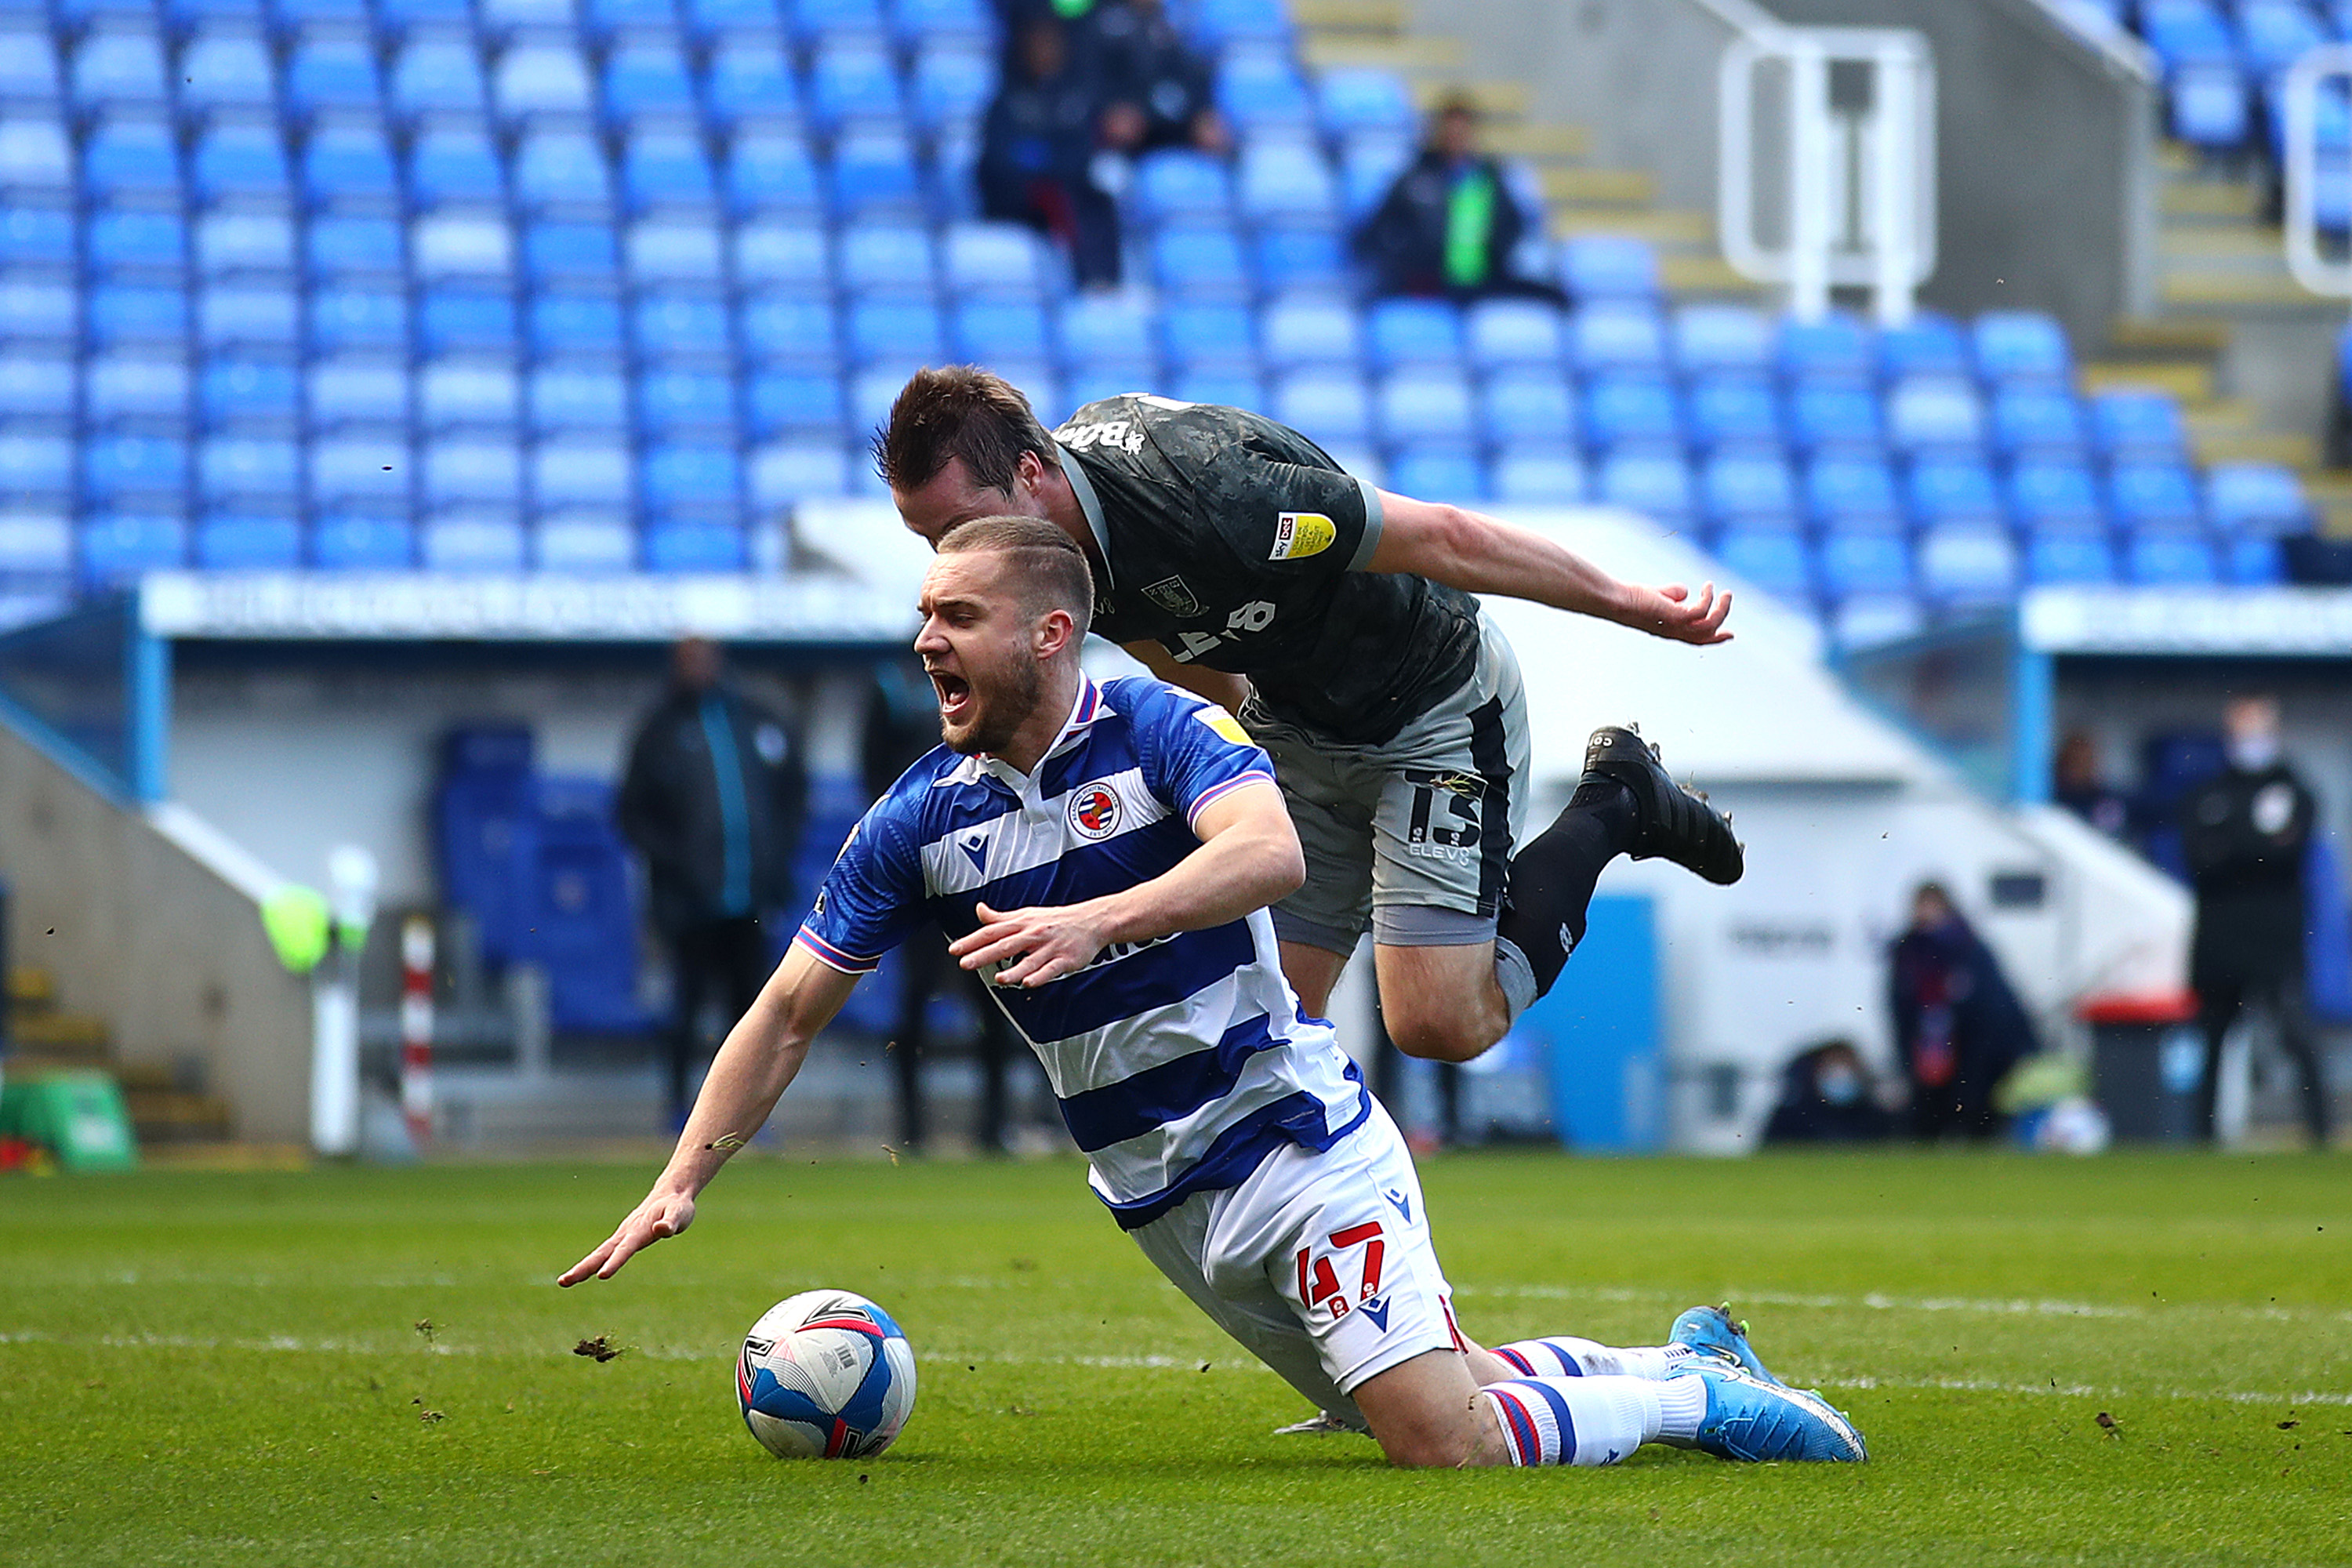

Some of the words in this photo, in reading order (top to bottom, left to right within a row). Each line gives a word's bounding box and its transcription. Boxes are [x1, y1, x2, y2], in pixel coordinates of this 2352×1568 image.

[1280, 519, 1291, 539] bet
[1276, 542, 1287, 557] sky
[1410, 844, 1470, 866] ELEV8
[1296, 1221, 1385, 1321] 47
